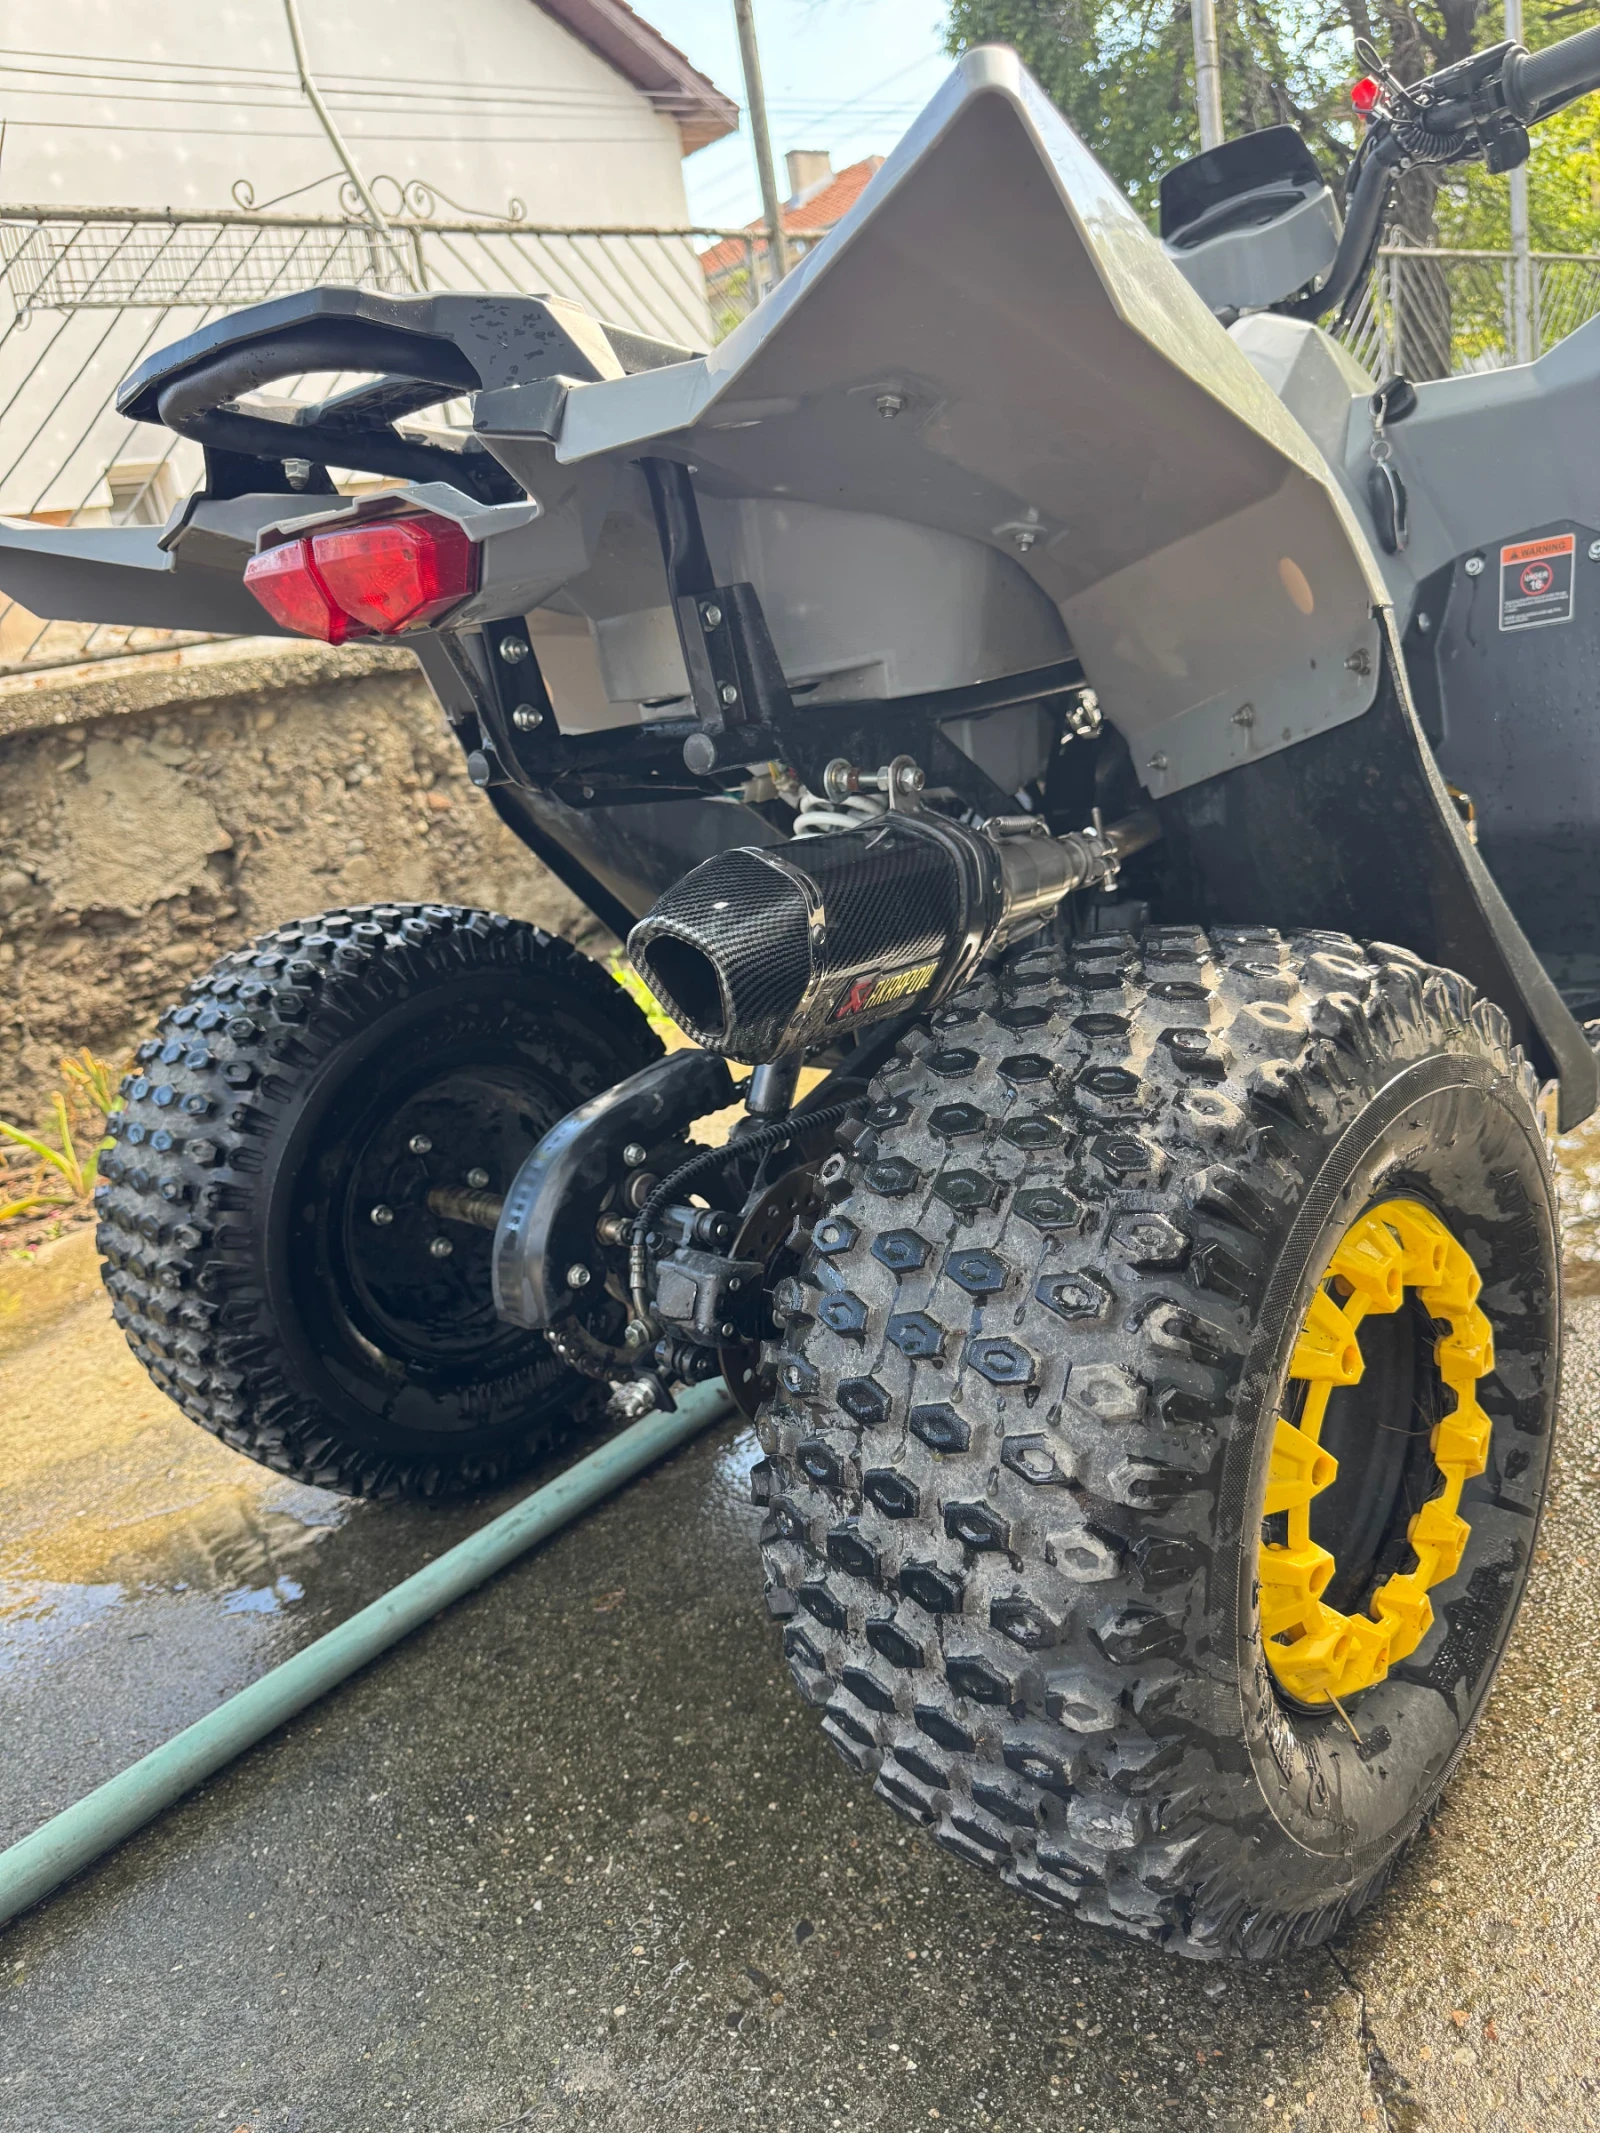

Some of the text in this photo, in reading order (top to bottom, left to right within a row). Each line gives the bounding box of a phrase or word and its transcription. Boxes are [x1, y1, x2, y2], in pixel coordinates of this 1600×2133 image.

[1522, 542, 1565, 556] WARNING
[1524, 571, 1548, 582] UNDER
[1530, 580, 1544, 590] 16
